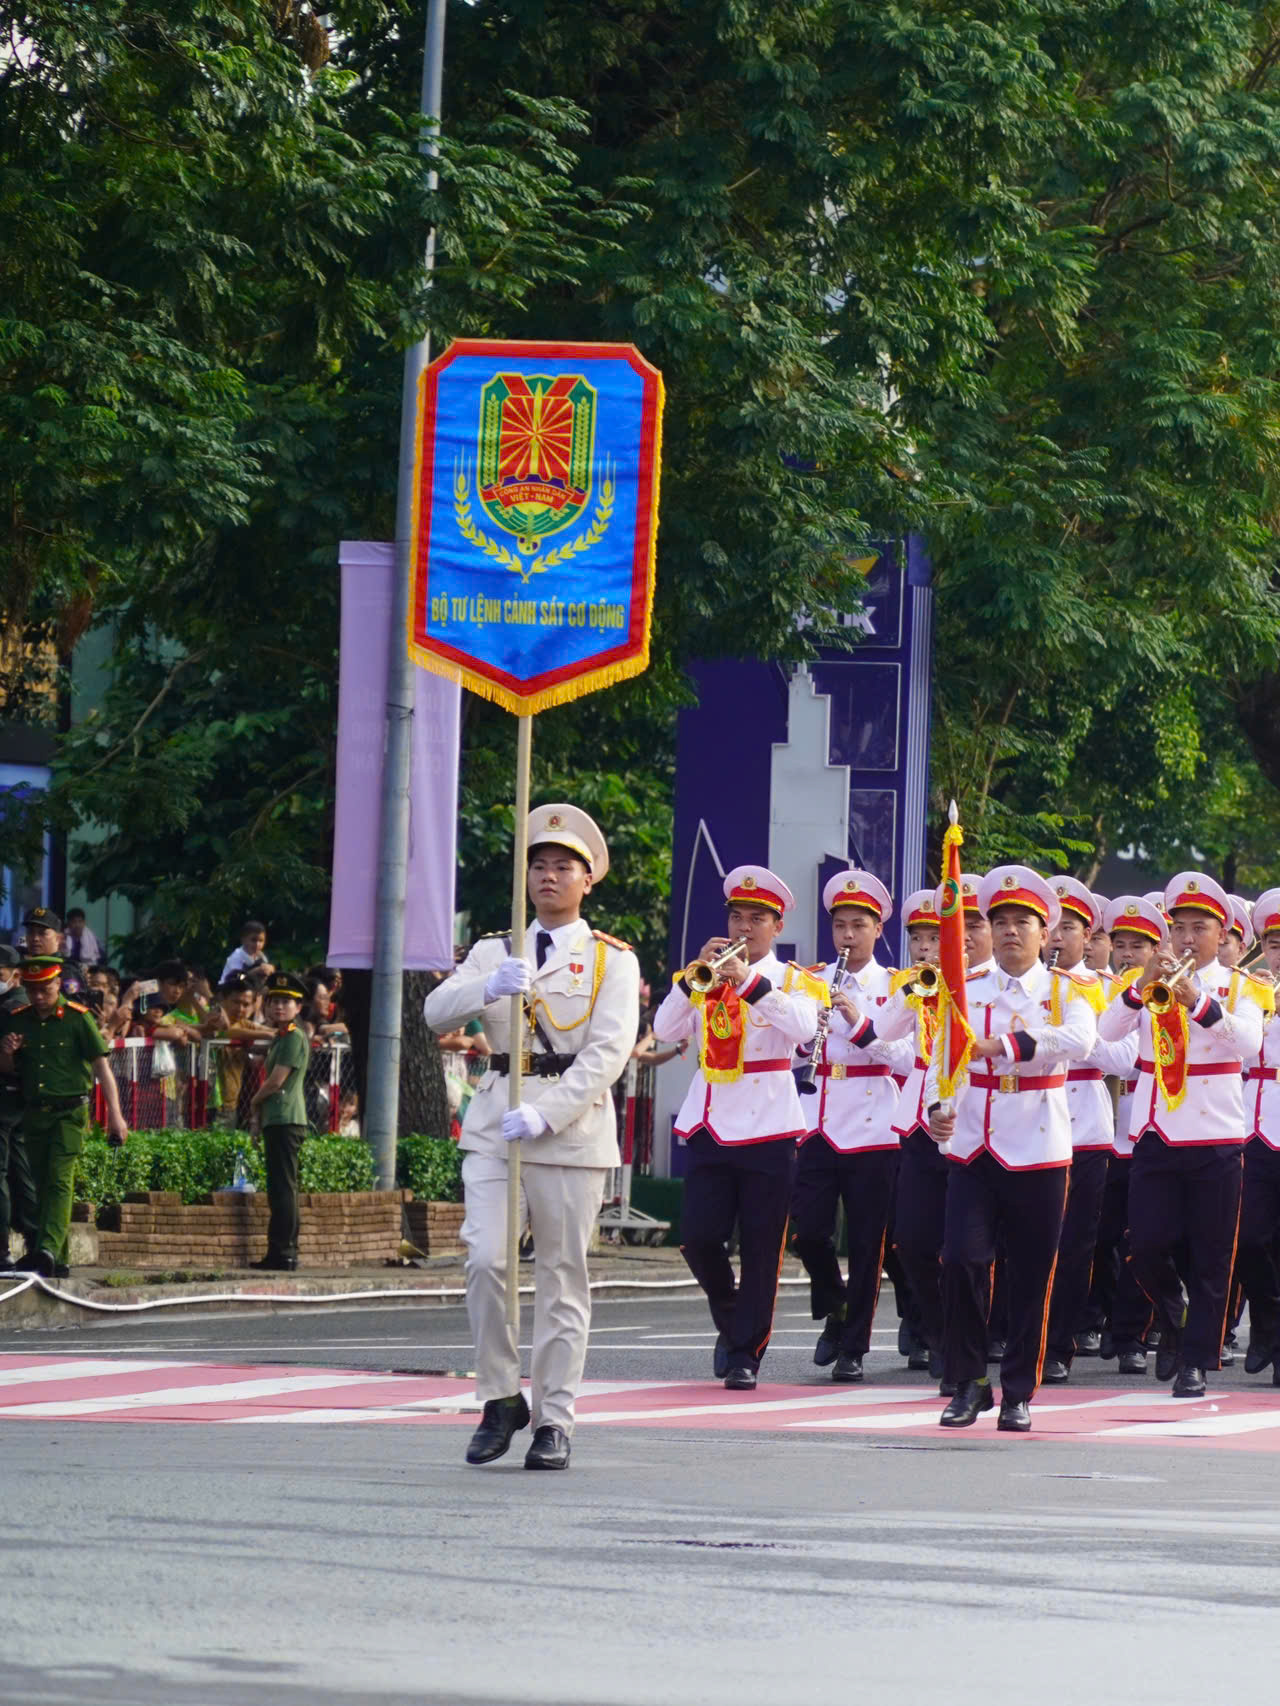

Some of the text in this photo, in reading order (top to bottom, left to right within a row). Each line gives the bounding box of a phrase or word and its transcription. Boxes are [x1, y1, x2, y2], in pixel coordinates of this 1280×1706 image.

[431, 592, 626, 634] BỘ TƯ LỆNH CẢNH SÁT CƠ ĐỘNG
